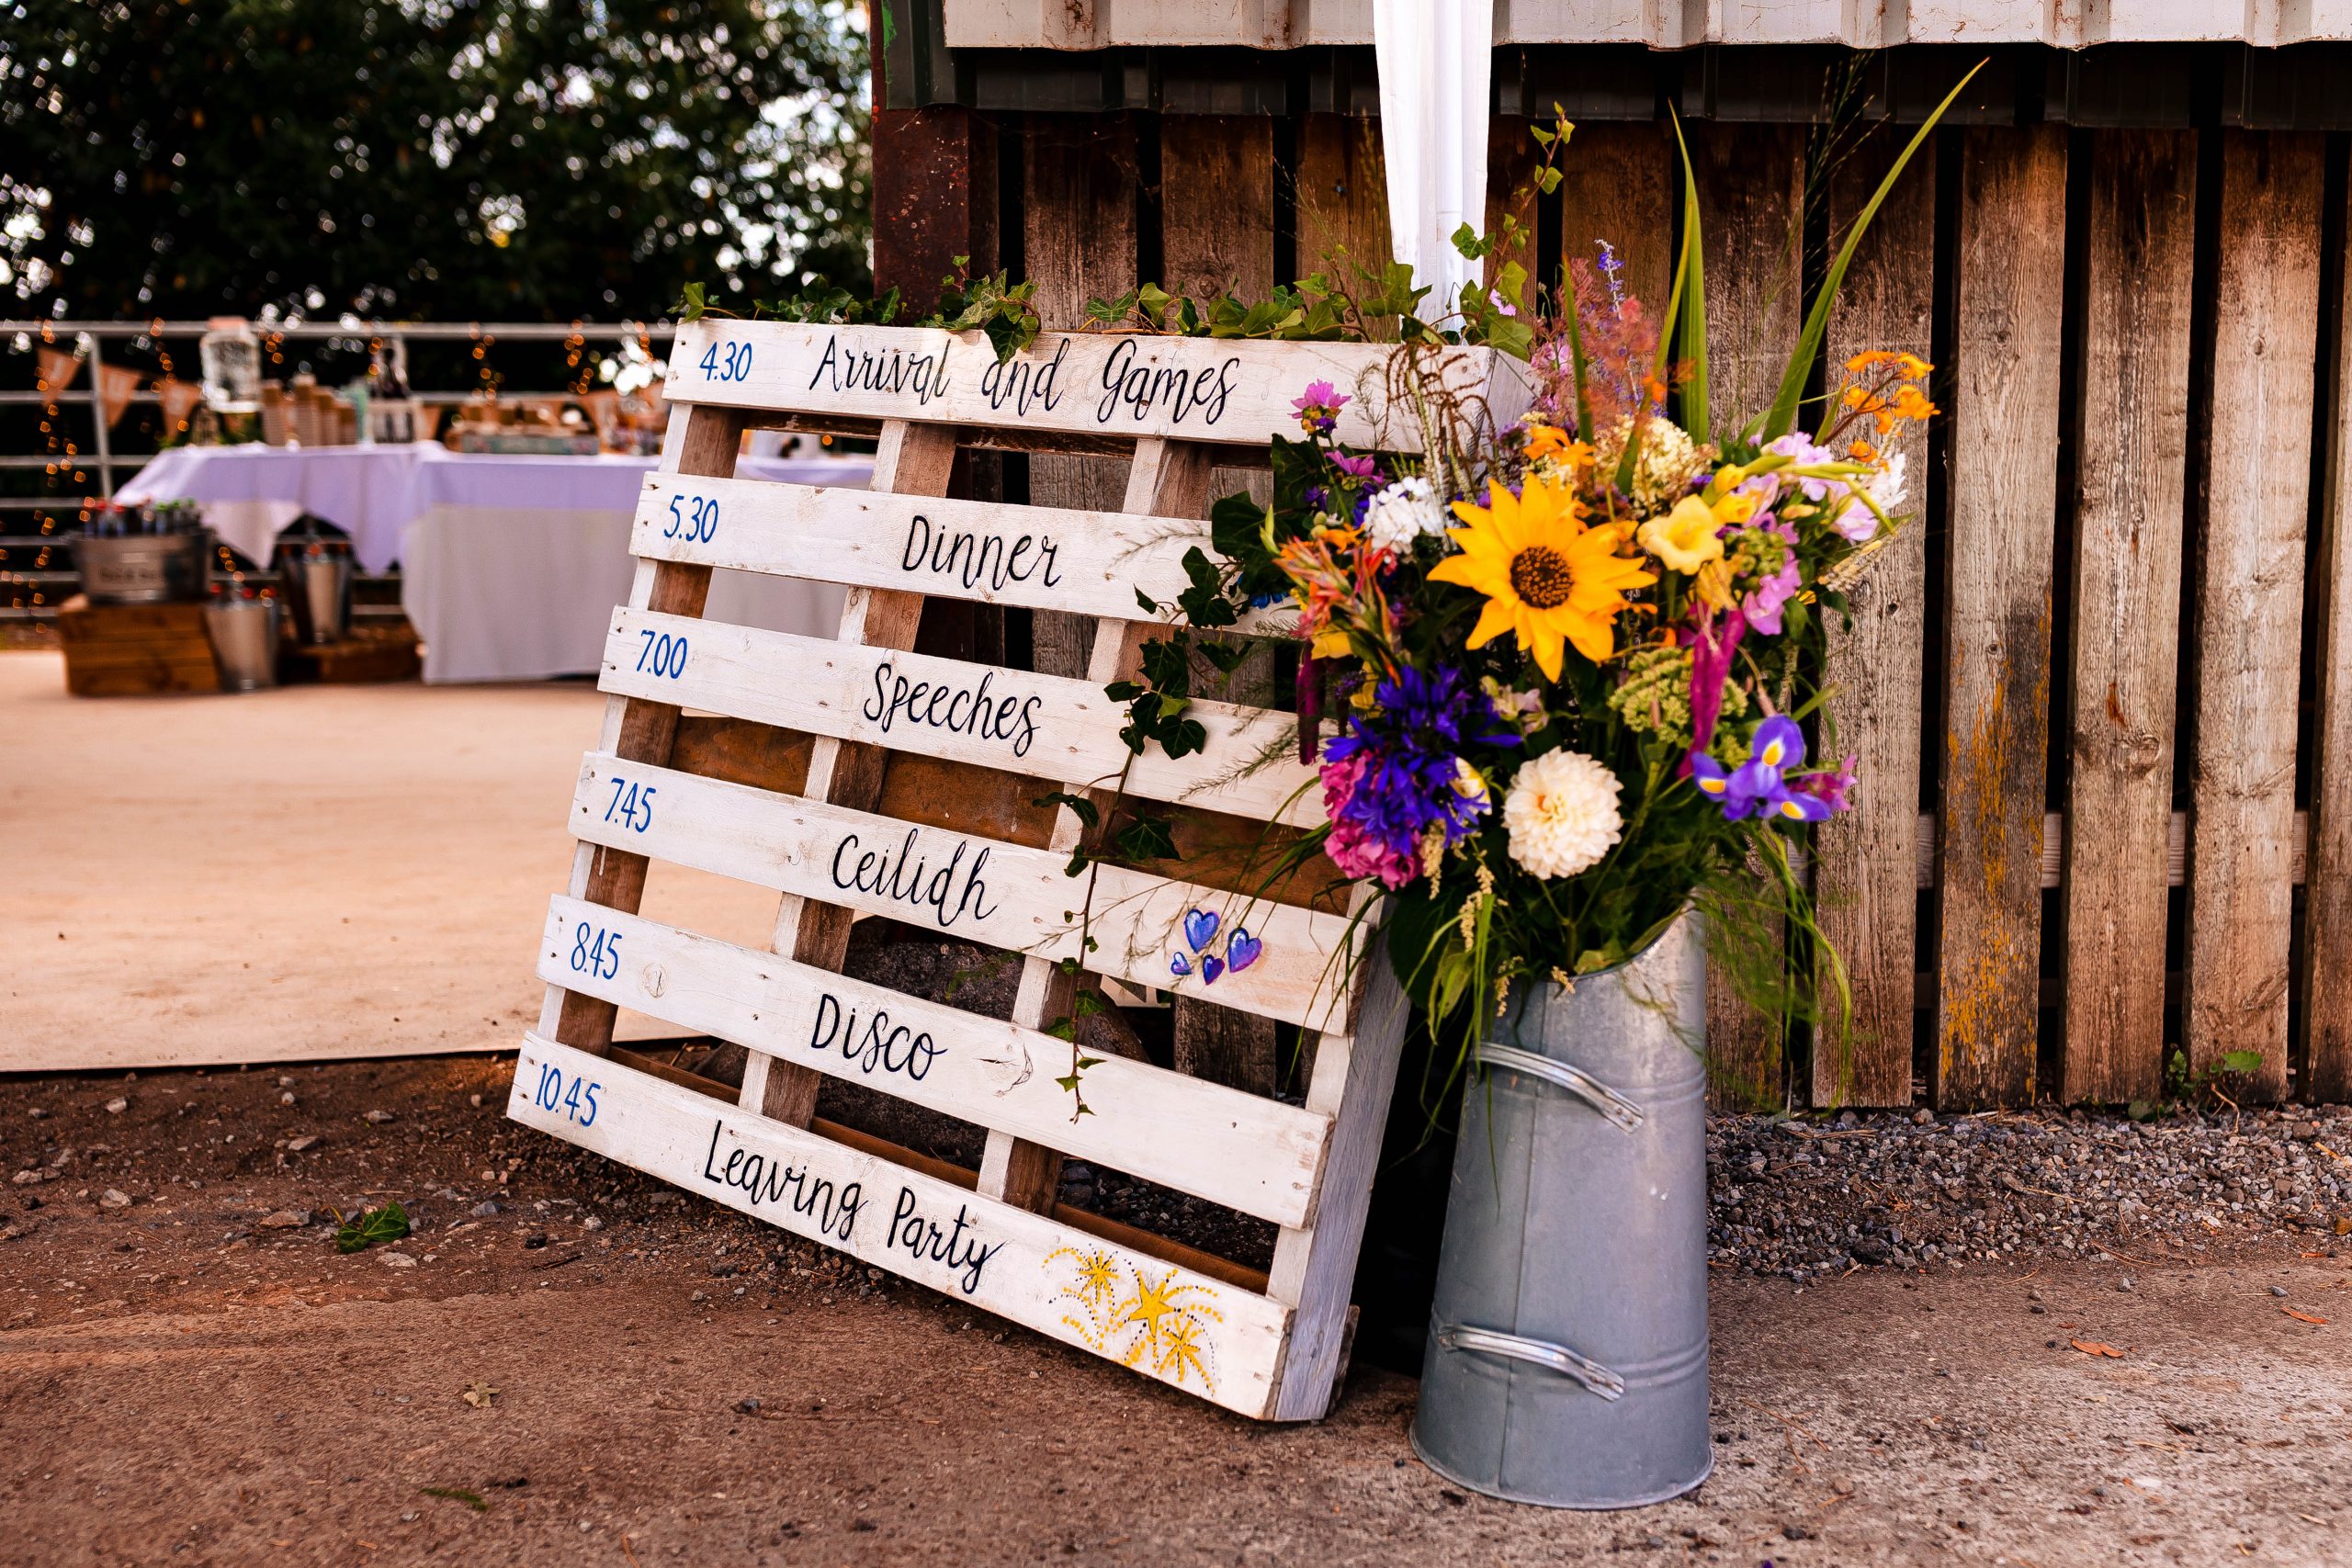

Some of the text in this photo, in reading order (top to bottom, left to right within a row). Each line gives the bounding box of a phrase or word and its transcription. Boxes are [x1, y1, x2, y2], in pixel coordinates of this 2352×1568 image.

[698, 334, 1240, 425] 4.30 Arrival and Games
[663, 494, 1062, 589] 5.30 Dinner
[636, 629, 1043, 757] 7.00 Speeches
[603, 778, 998, 928] 7.45 Ceilidh
[570, 921, 947, 1082] 8.45 Disco
[535, 1063, 1005, 1295] 10.45 Leaving Party
